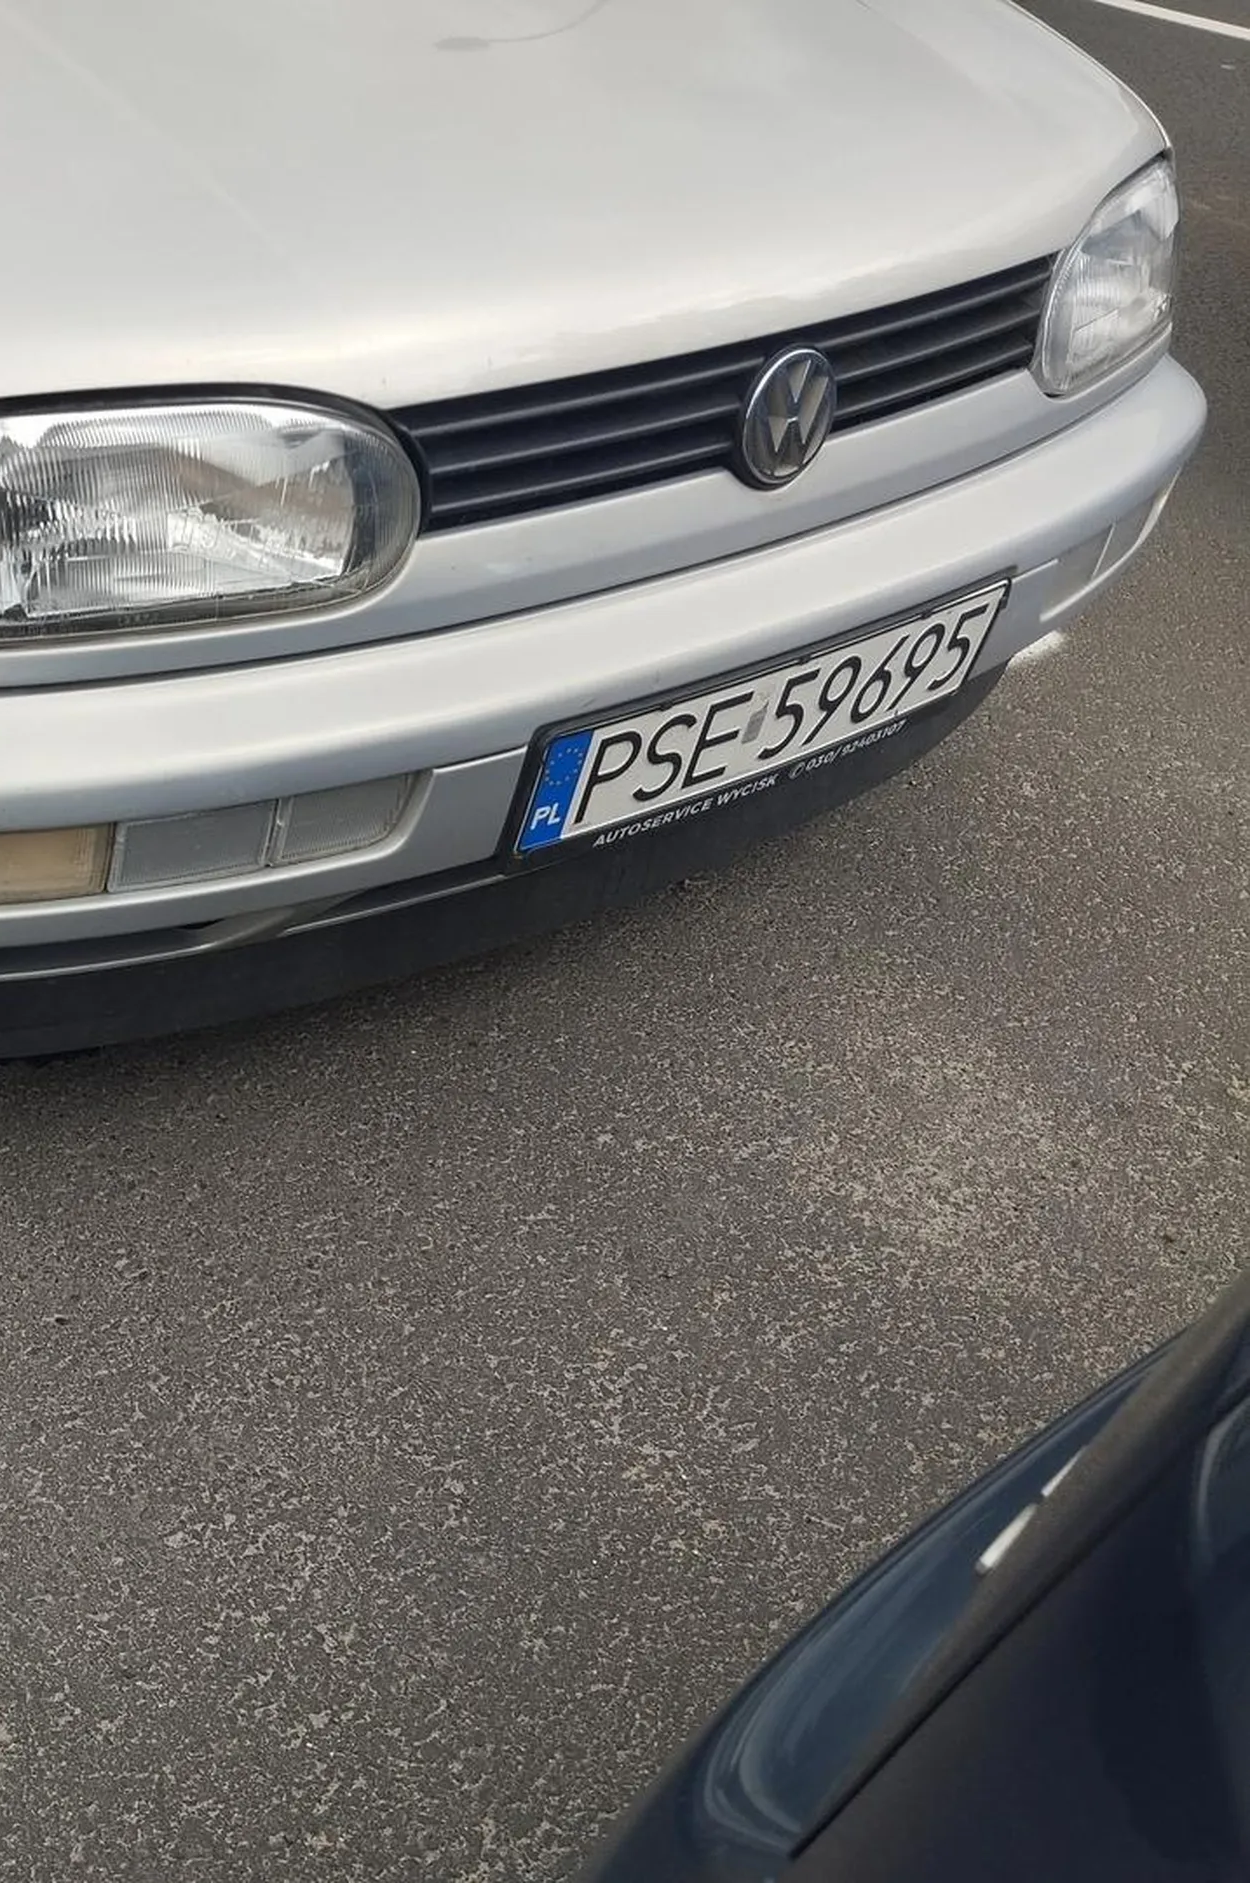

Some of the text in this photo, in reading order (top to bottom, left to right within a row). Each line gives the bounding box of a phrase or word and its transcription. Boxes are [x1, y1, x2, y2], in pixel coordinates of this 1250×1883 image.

[573, 606, 988, 825] PSE 59695
[530, 801, 561, 830] PL
[592, 798, 712, 848] AUTOSERVICE
[716, 774, 780, 807] WYCISK
